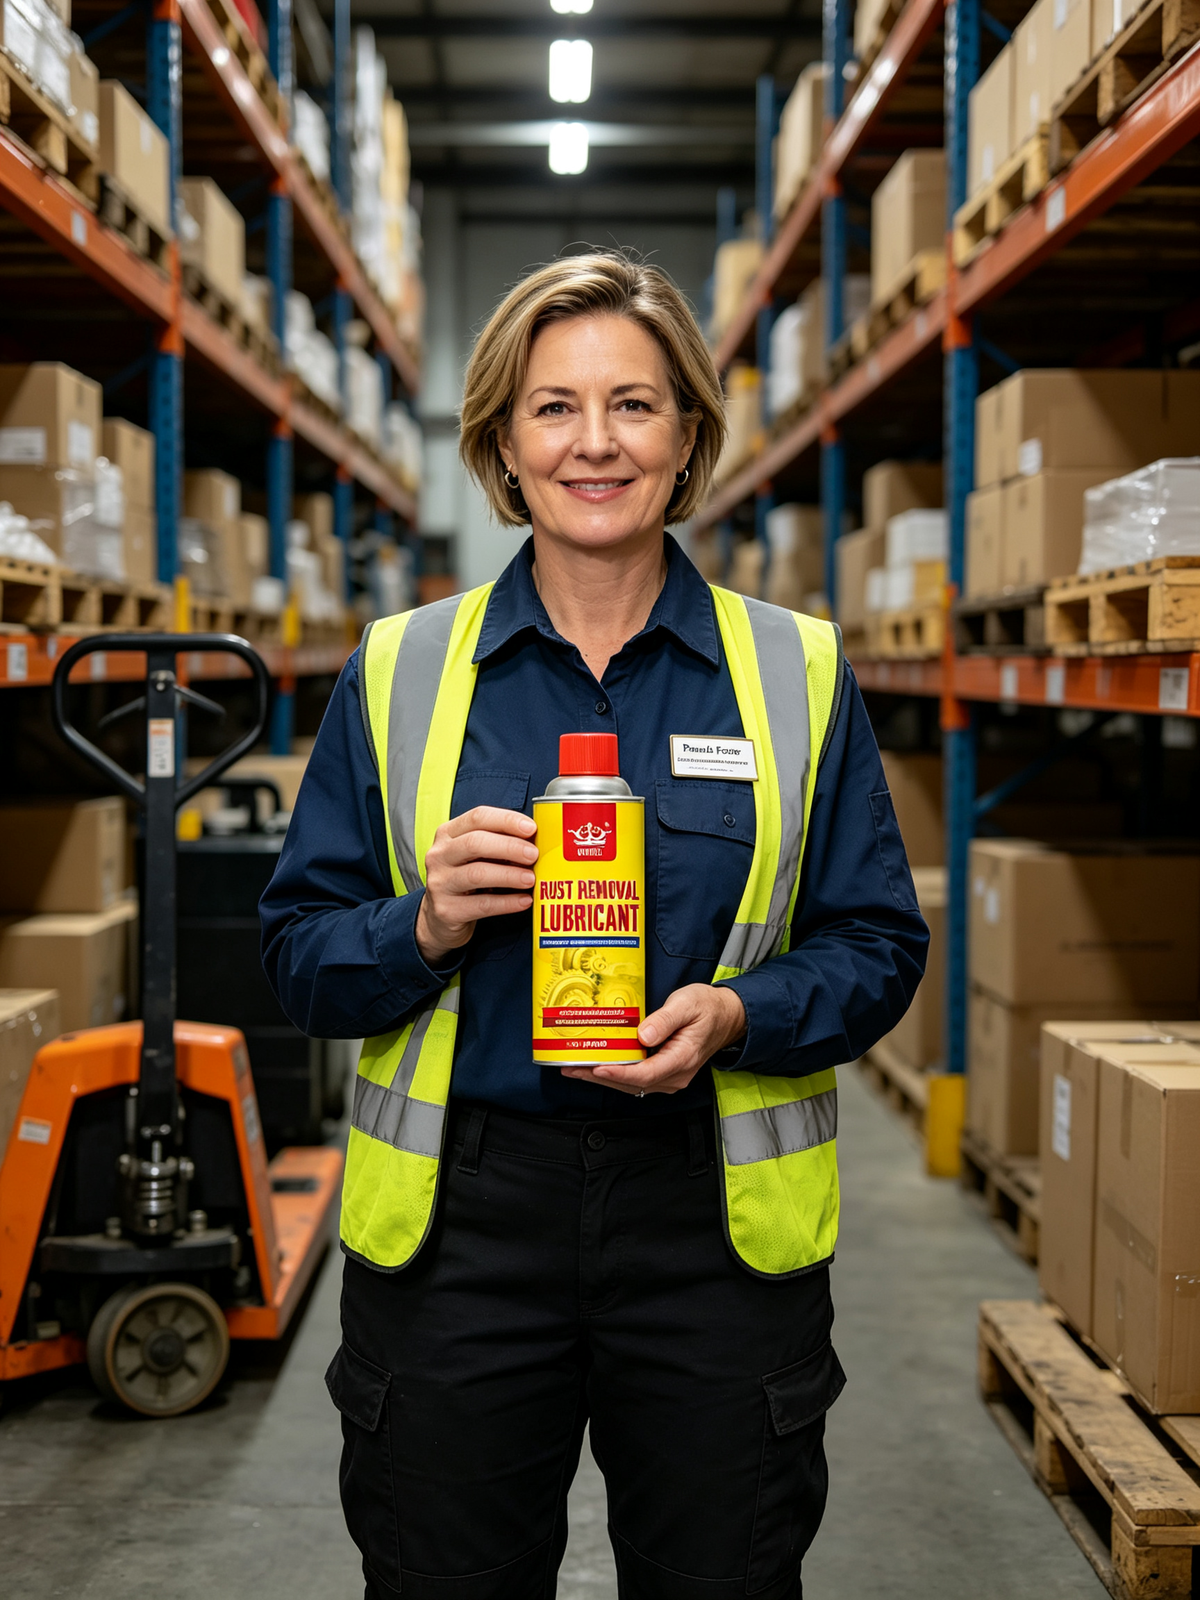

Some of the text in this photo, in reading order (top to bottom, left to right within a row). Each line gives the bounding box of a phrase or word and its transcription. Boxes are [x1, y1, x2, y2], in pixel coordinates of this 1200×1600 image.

[540, 880, 639, 900] RUST REMOVAL
[540, 904, 639, 932] LUBRICANT
